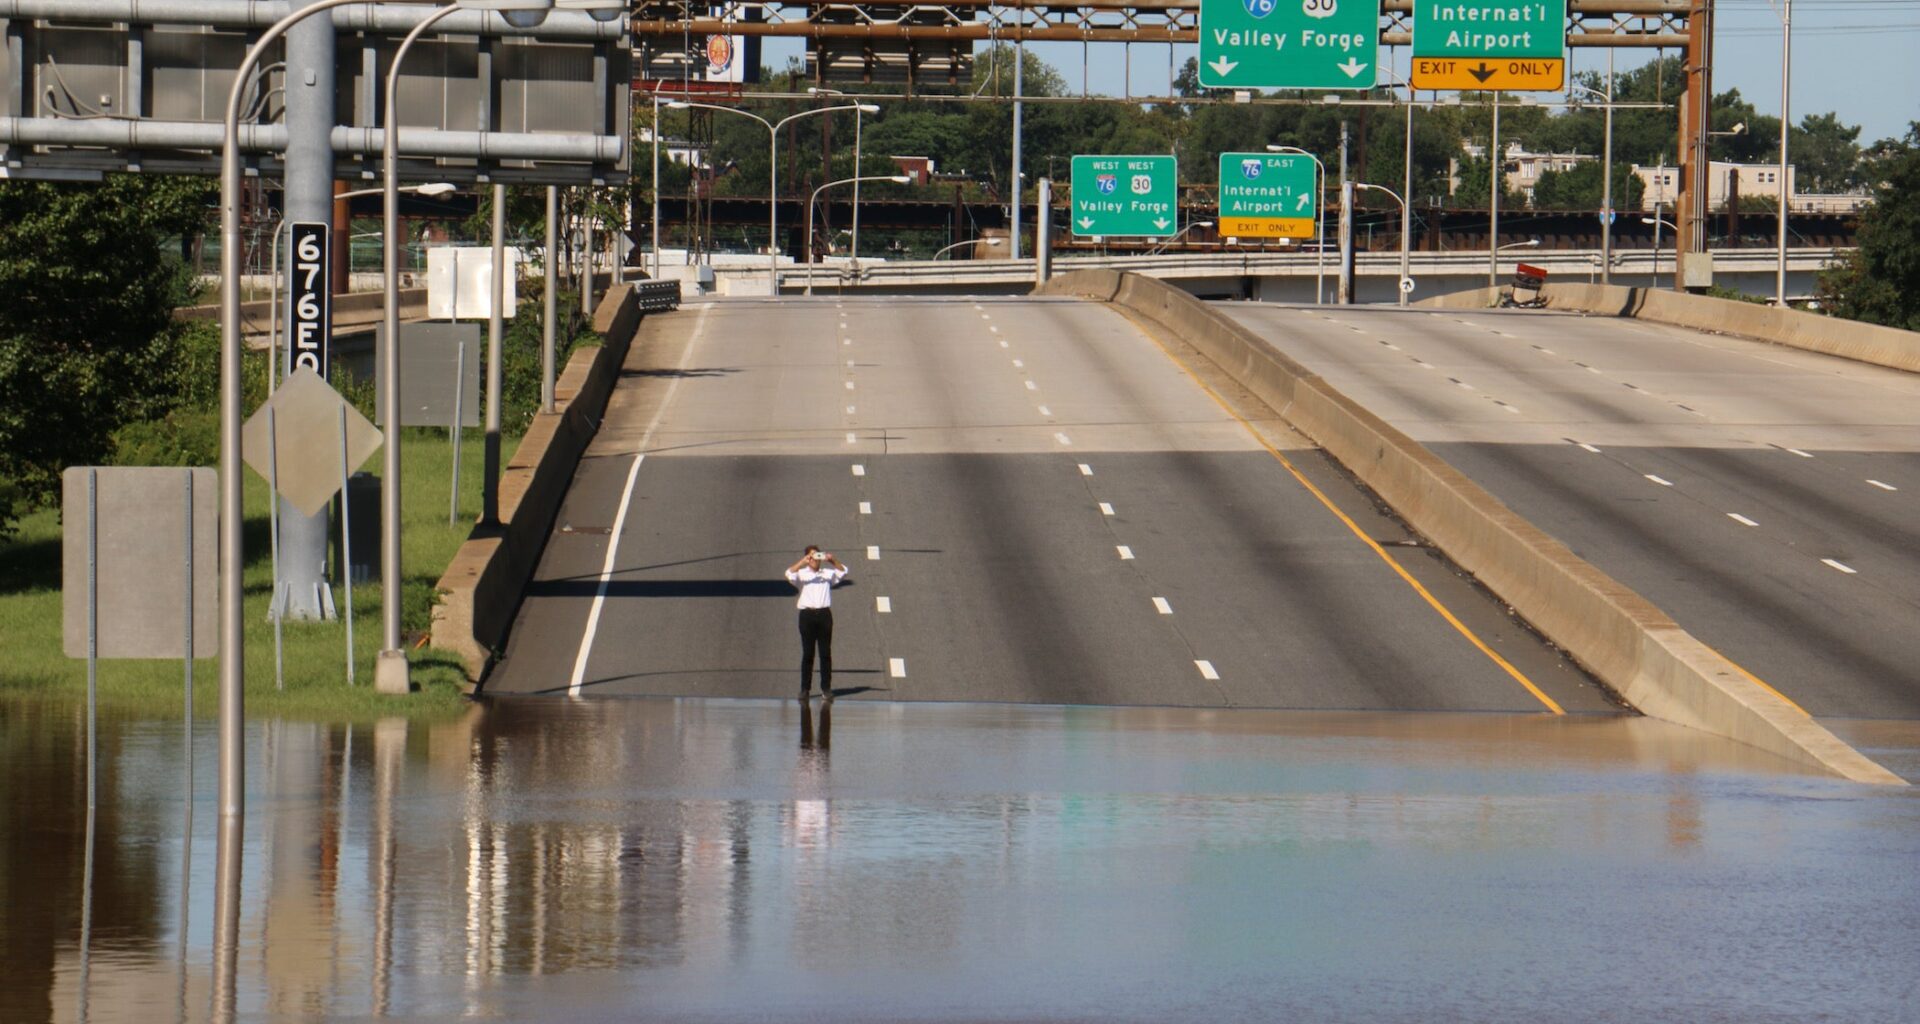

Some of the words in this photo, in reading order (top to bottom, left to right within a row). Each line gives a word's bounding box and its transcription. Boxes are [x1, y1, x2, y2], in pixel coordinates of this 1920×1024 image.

[1432, 4, 1546, 21] Internat'l
[1214, 28, 1287, 51] Valley
[1302, 30, 1365, 52] Forge
[1445, 30, 1532, 51] Airport
[1420, 61, 1457, 74] EXIT
[1508, 62, 1555, 76] ONLY
[1092, 161, 1120, 170] WEST
[1127, 161, 1155, 170] WEST
[1243, 164, 1259, 176] 76
[1266, 159, 1295, 168] EAST
[1098, 179, 1114, 191] 76
[1133, 178, 1150, 190] 30
[1224, 184, 1291, 196] Internat'l
[1079, 200, 1123, 214] Valley
[1131, 201, 1169, 214] Forge
[1232, 200, 1283, 213] Airport
[1237, 223, 1260, 232] EXIT
[1268, 223, 1296, 233] ONLY
